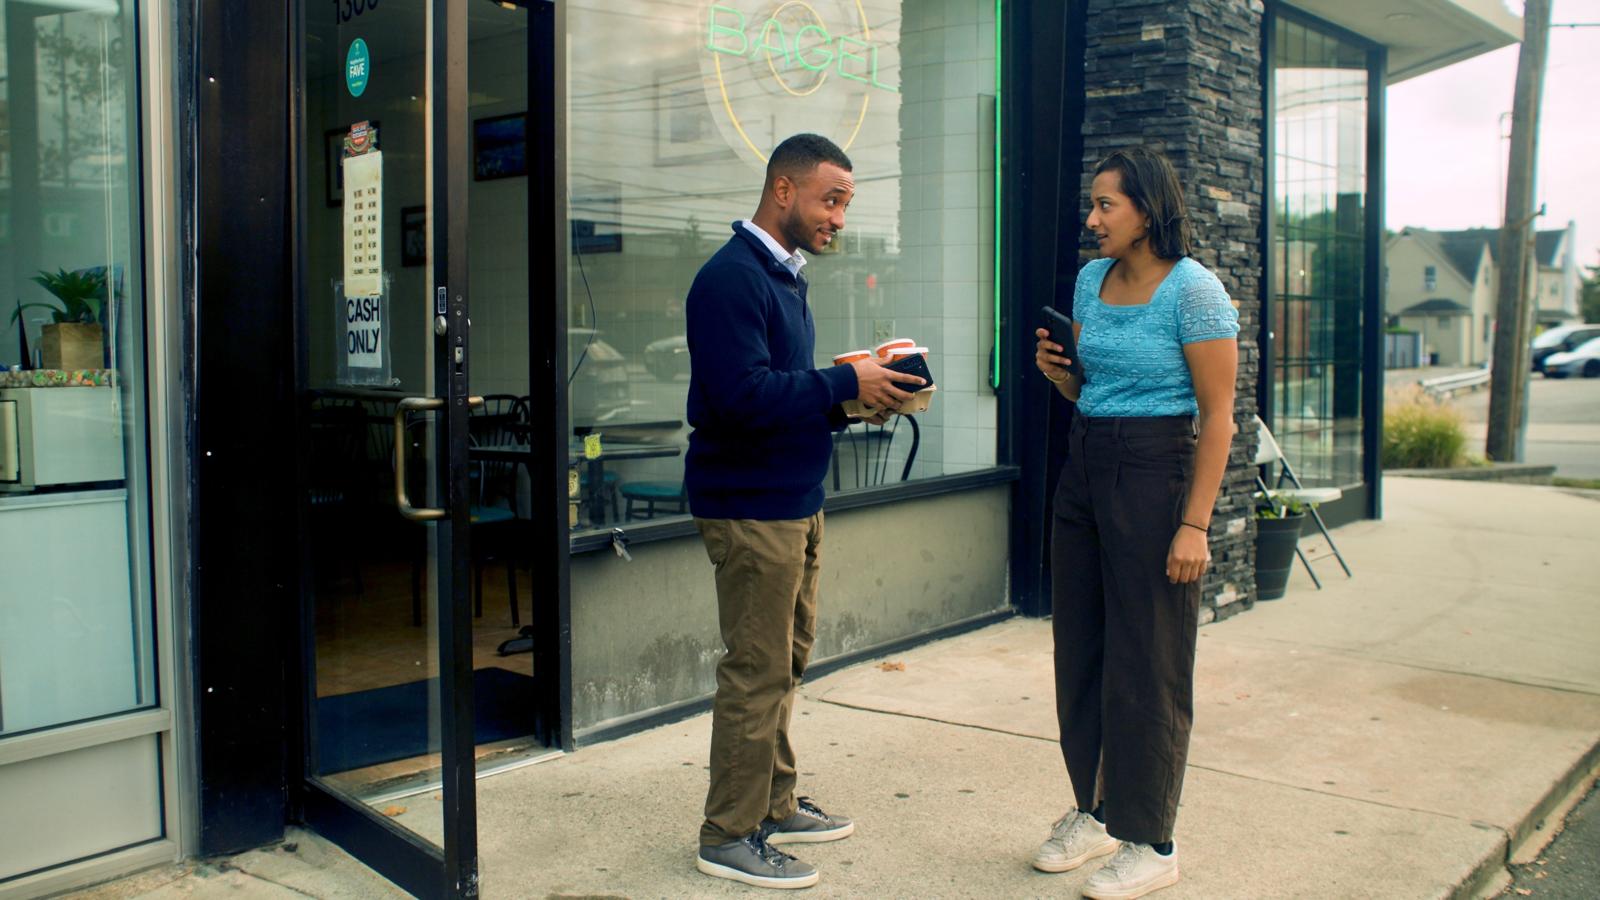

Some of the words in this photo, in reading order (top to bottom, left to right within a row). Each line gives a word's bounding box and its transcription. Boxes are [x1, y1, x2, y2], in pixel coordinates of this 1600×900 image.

[707, 3, 899, 93] BAGEL
[349, 62, 365, 79] FAVE
[347, 298, 380, 323] CASH
[347, 328, 380, 354] ONLY
